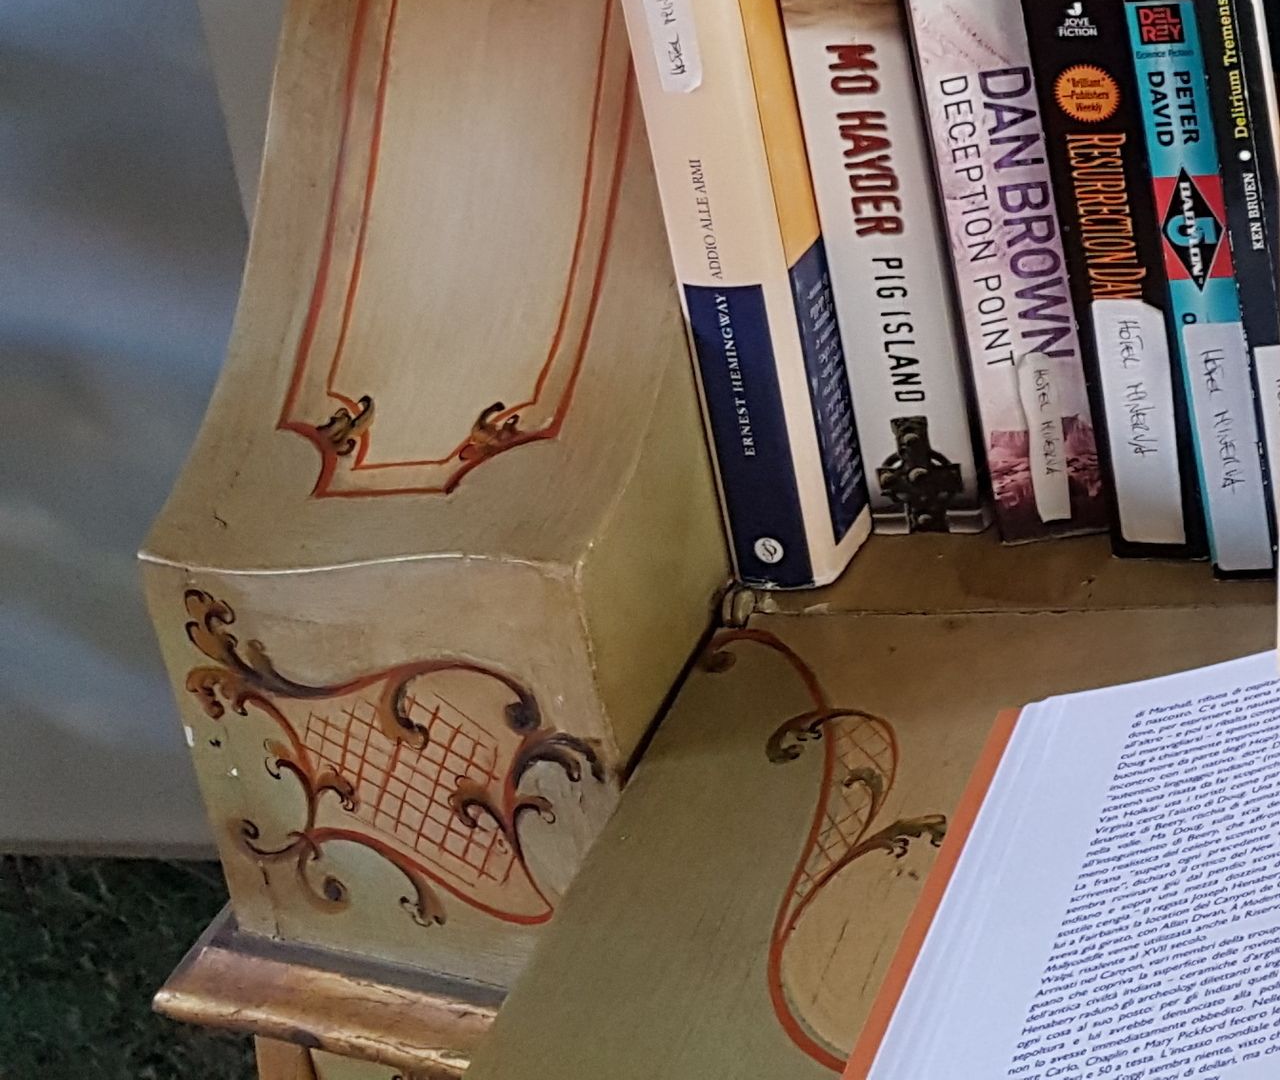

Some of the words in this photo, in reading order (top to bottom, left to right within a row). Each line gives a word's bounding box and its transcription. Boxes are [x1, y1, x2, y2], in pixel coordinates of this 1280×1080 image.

[1139, 7, 1180, 24] DEL
[1143, 24, 1181, 41] REY
[825, 43, 881, 95] MO
[978, 66, 1045, 172] DAN
[1148, 72, 1173, 147] DAVID
[1173, 72, 1200, 146] PETER
[1229, 70, 1249, 139] Delirium
[689, 159, 706, 194] ARMI
[837, 111, 905, 238] HAYDER
[1066, 132, 1138, 266] RESURRECTION
[1242, 173, 1261, 219] BRUEN
[697, 198, 713, 231] ALLE
[939, 74, 995, 262] DECEPTION
[974, 274, 1015, 367] POINT
[1251, 220, 1266, 251] KEN
[703, 234, 723, 280] ADDIO
[872, 257, 908, 301] PIG
[999, 180, 1075, 360] BROWN
[715, 292, 744, 392] HEMINGWAY
[880, 311, 925, 404] ISLAND
[735, 397, 756, 456] ERNEST
